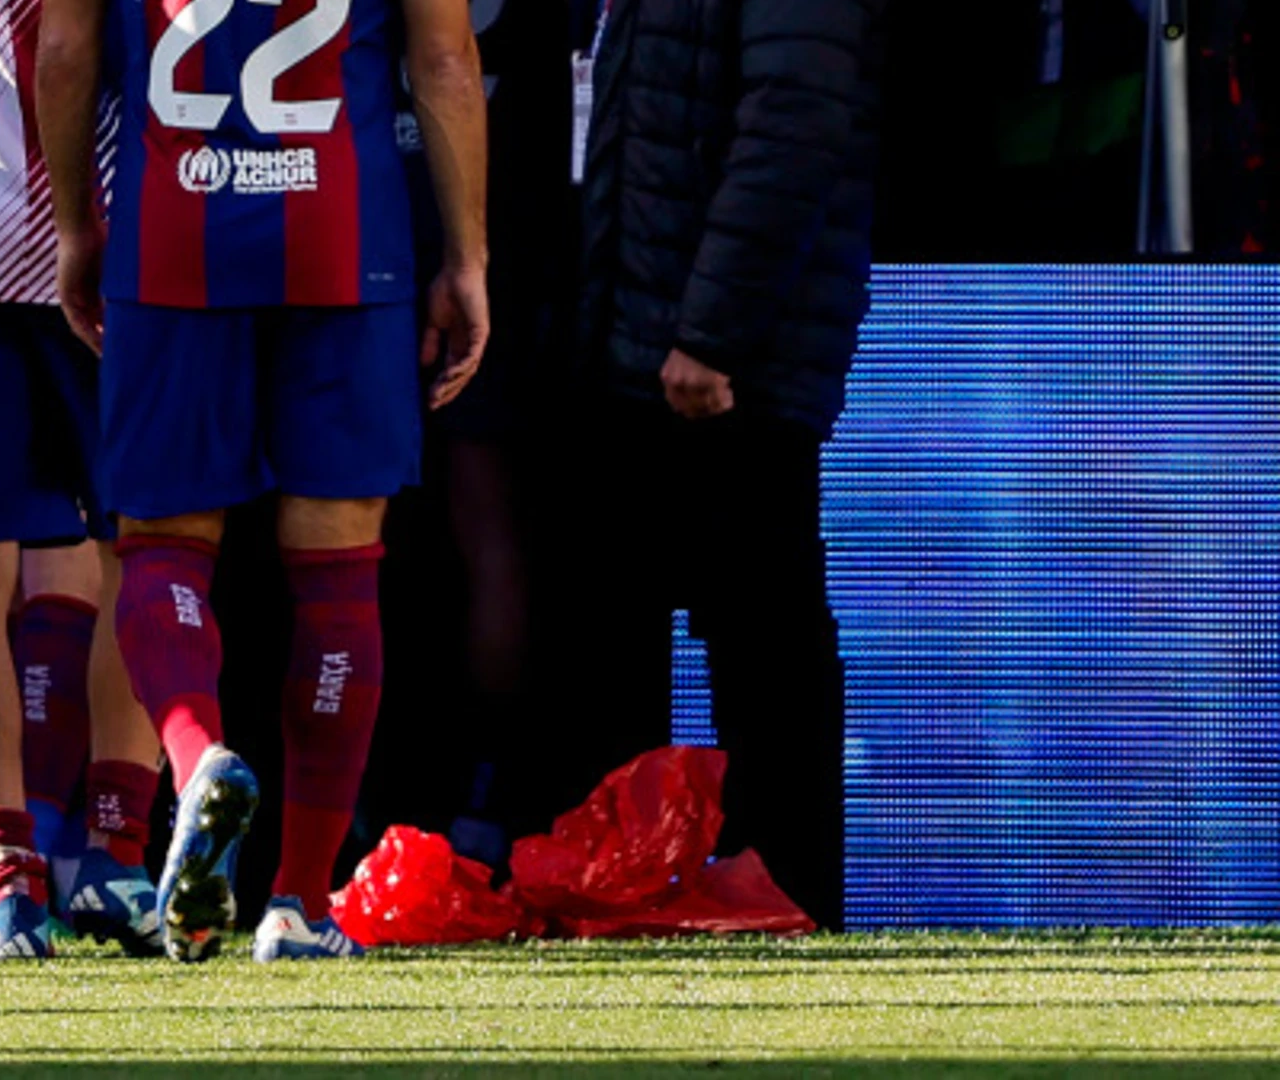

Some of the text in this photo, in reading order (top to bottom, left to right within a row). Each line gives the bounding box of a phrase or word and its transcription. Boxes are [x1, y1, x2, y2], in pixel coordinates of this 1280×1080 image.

[233, 148, 316, 169] UNHCR
[233, 166, 317, 185] ACNUR
[313, 650, 353, 713] BARÇA
